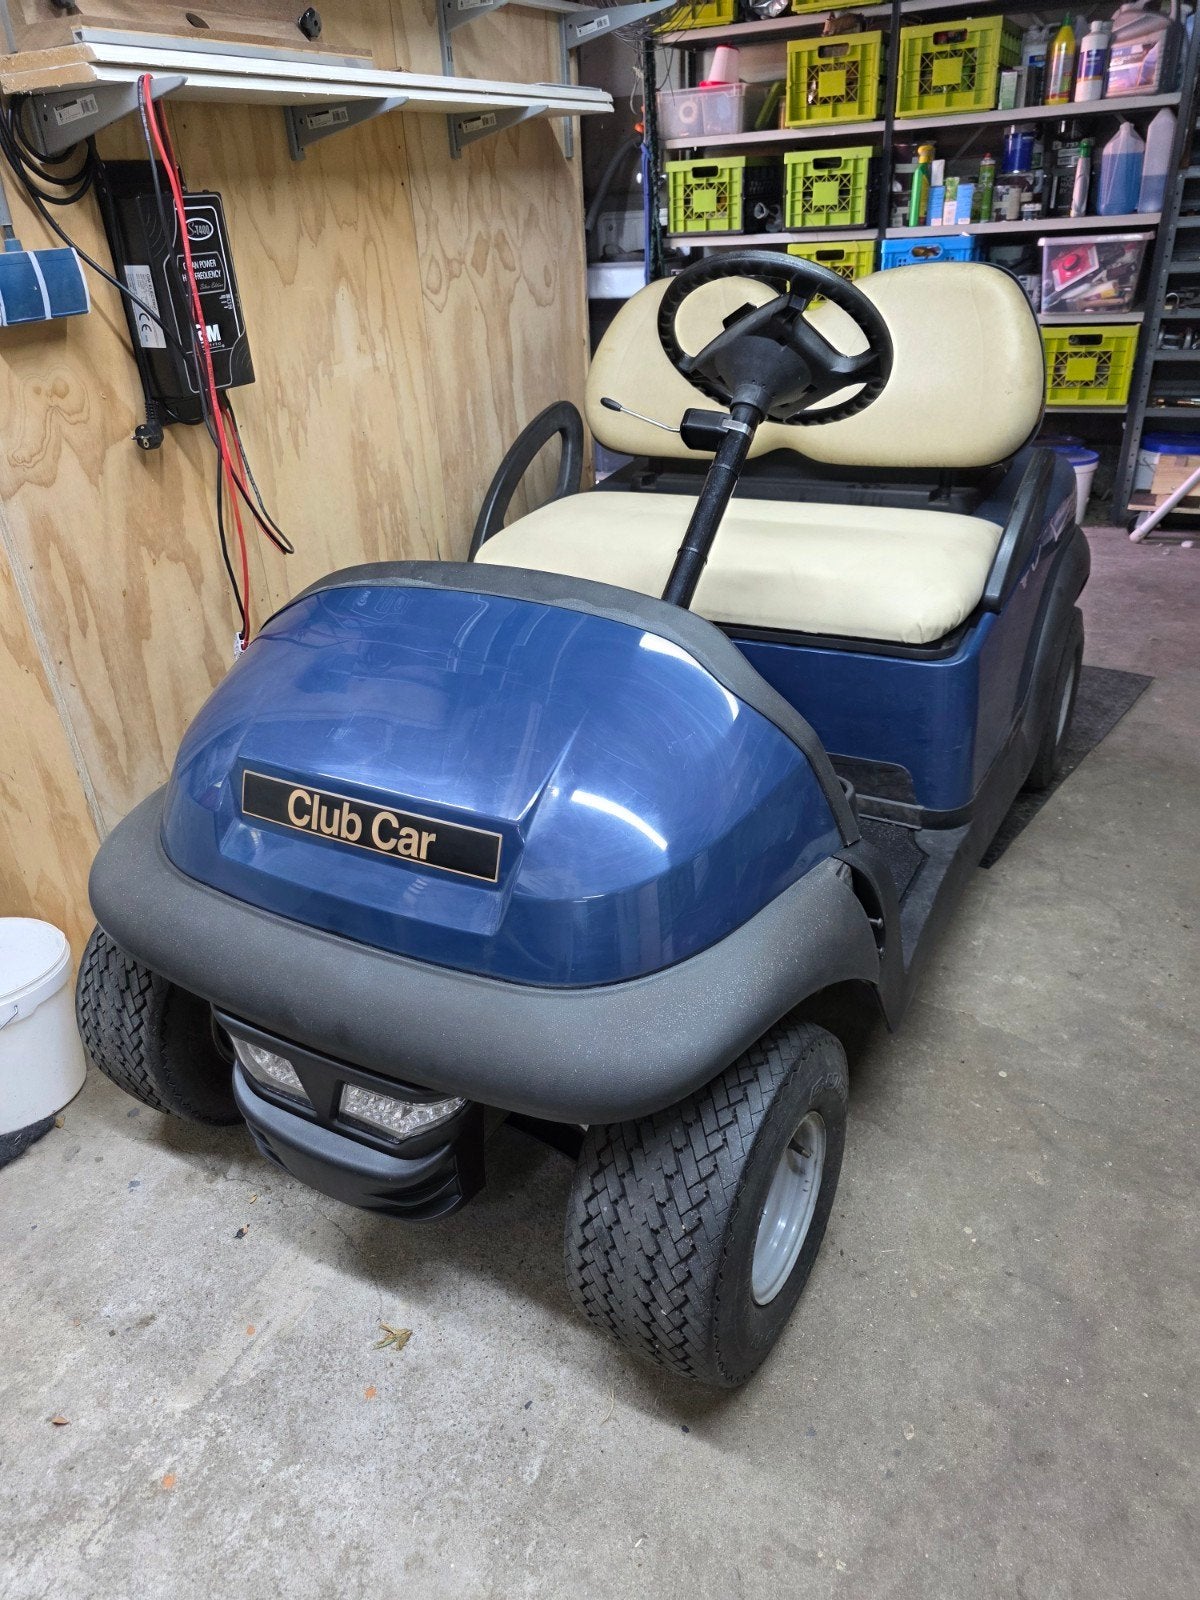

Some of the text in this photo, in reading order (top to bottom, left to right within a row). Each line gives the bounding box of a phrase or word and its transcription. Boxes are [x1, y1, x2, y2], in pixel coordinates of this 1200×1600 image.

[200, 259, 217, 269] POWER
[194, 270, 221, 281] FREQUENCY
[287, 789, 437, 860] Club Car
